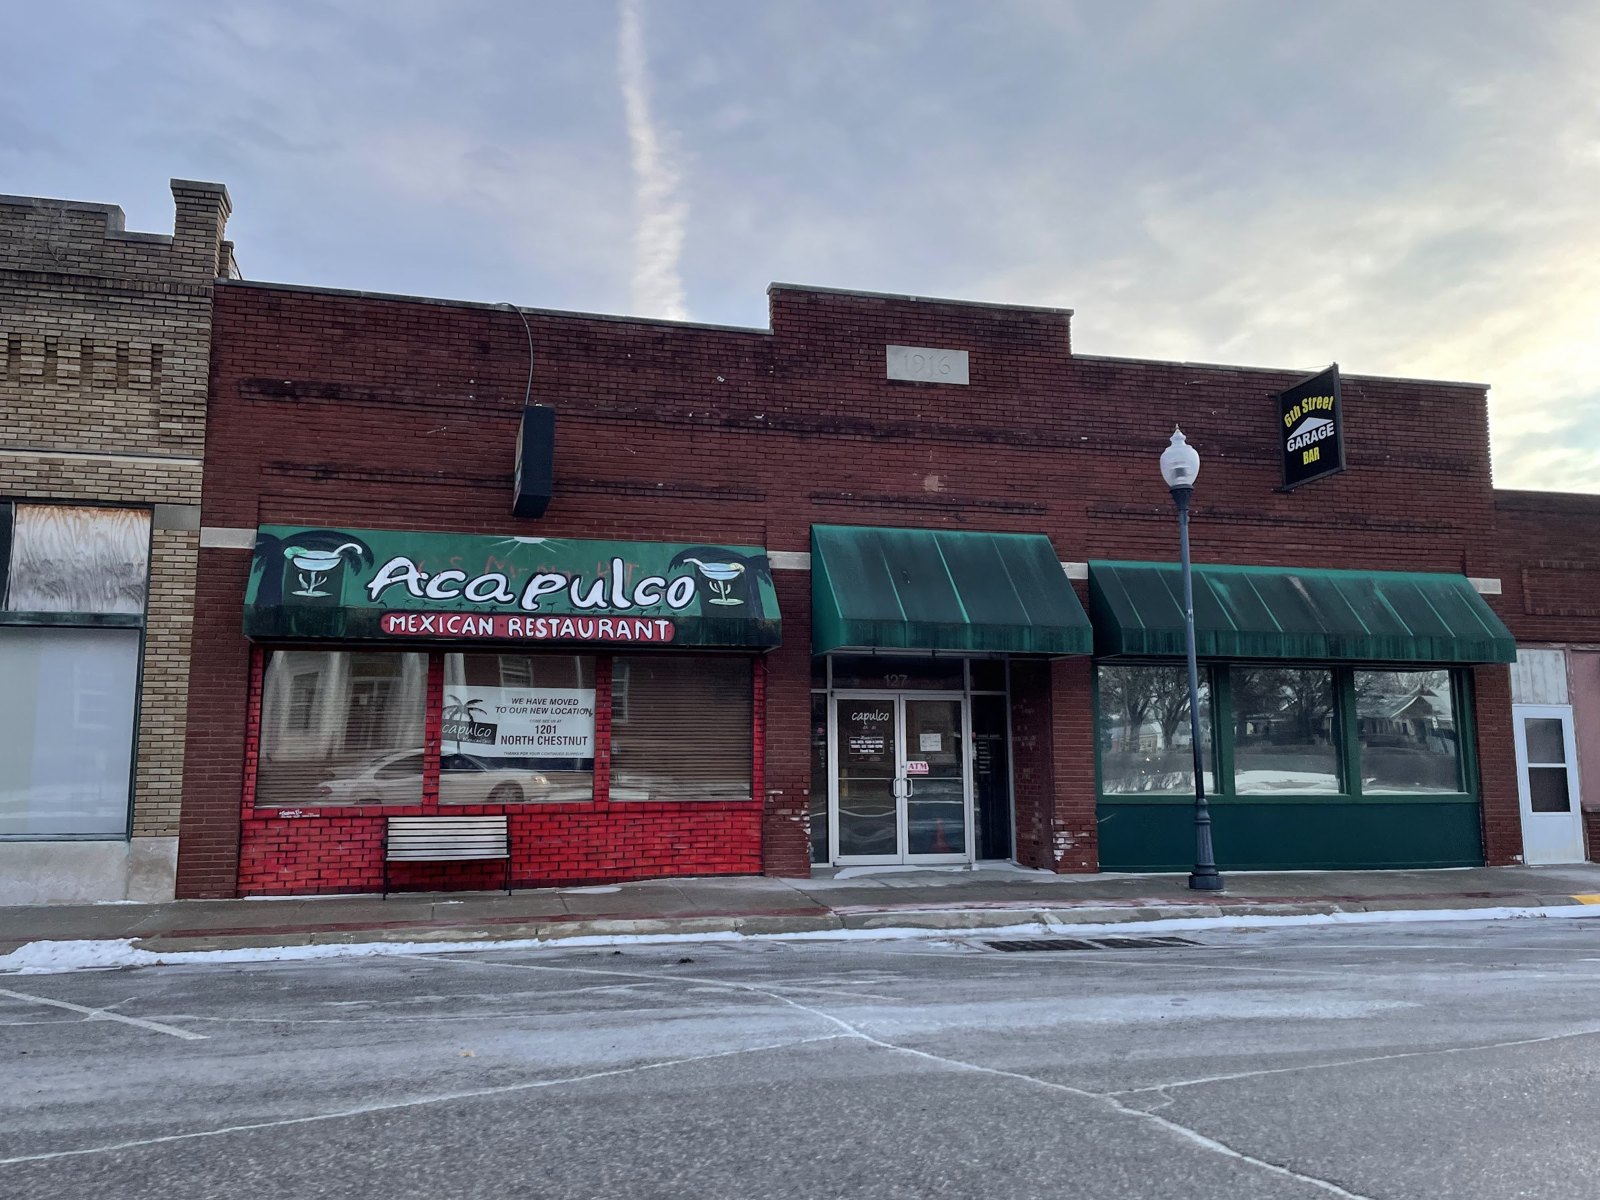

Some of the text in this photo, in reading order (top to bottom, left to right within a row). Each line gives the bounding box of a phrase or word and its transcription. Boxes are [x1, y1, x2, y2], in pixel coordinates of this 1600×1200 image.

[903, 353, 951, 376] 1916
[1284, 396, 1334, 428] 6th Street
[1286, 422, 1335, 452] GARAGE
[1303, 447, 1320, 465] BAR
[367, 556, 695, 610] Acapulco
[388, 614, 670, 640] MEXICAN RESTAURANT
[883, 674, 908, 688] 127
[511, 697, 524, 705] WE
[549, 698, 579, 706] MOVED
[495, 706, 507, 714] TO
[508, 707, 528, 715] OUR
[530, 707, 549, 715] NEW
[851, 709, 890, 725] capulco
[535, 724, 557, 735] 1201
[500, 735, 534, 746] NORTH
[537, 735, 588, 747] CHESTNUT
[909, 762, 928, 770] ATM
